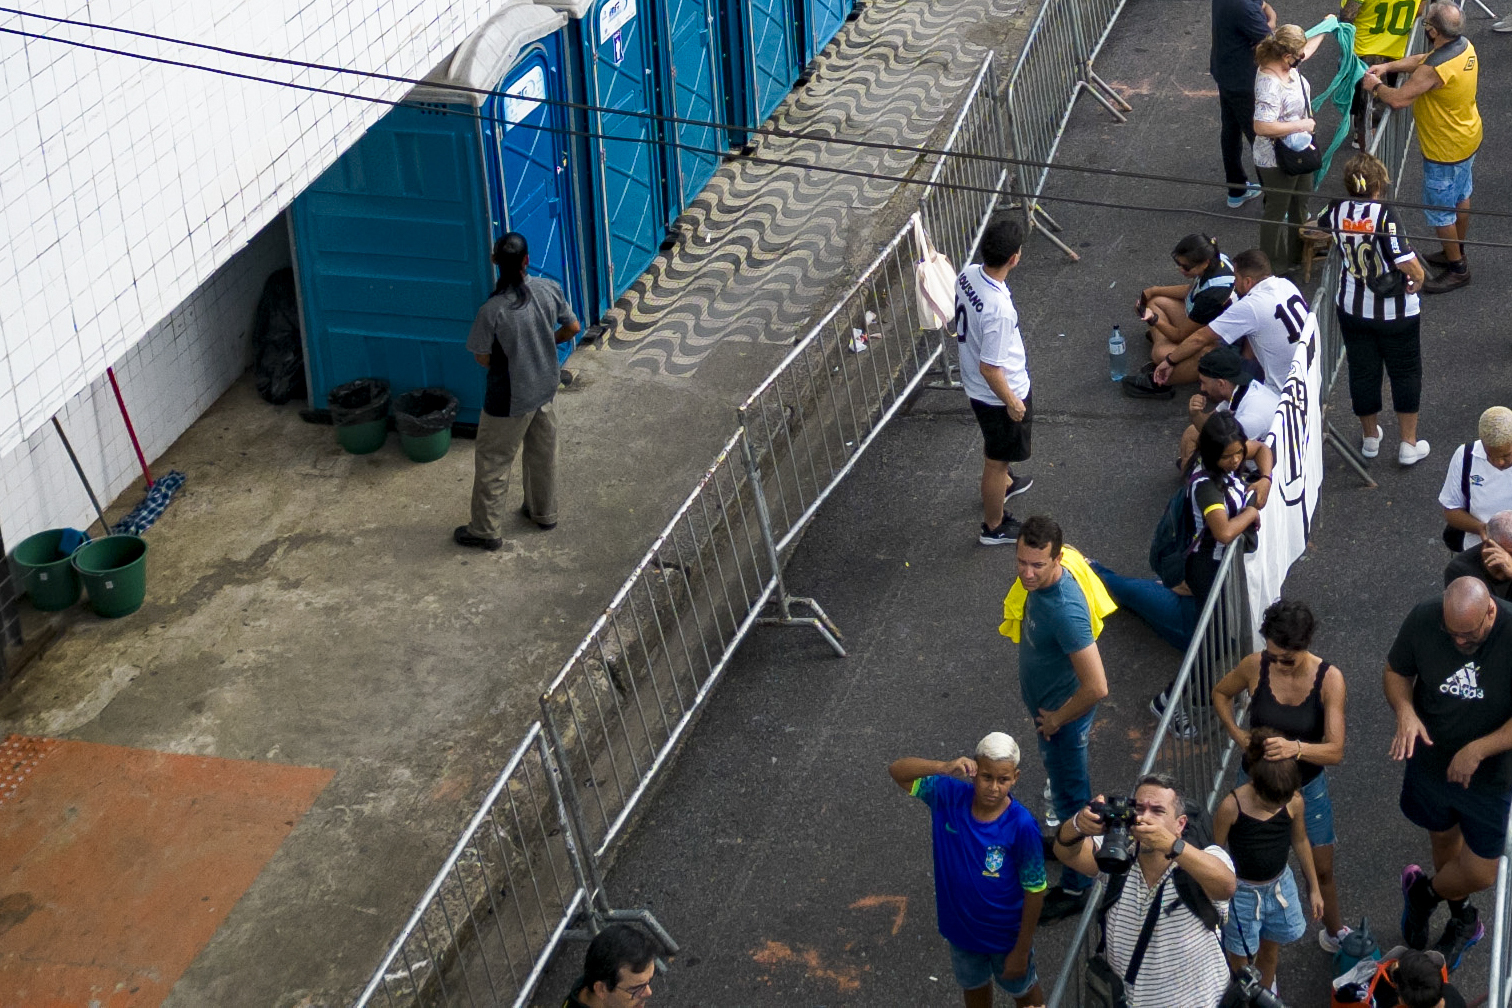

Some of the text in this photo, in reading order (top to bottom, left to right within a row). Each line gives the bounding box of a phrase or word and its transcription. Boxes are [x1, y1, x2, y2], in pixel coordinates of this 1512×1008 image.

[1369, 0, 1415, 36] 10
[1343, 242, 1384, 280] 10
[1274, 294, 1309, 344] 10
[1439, 682, 1484, 700] addas
